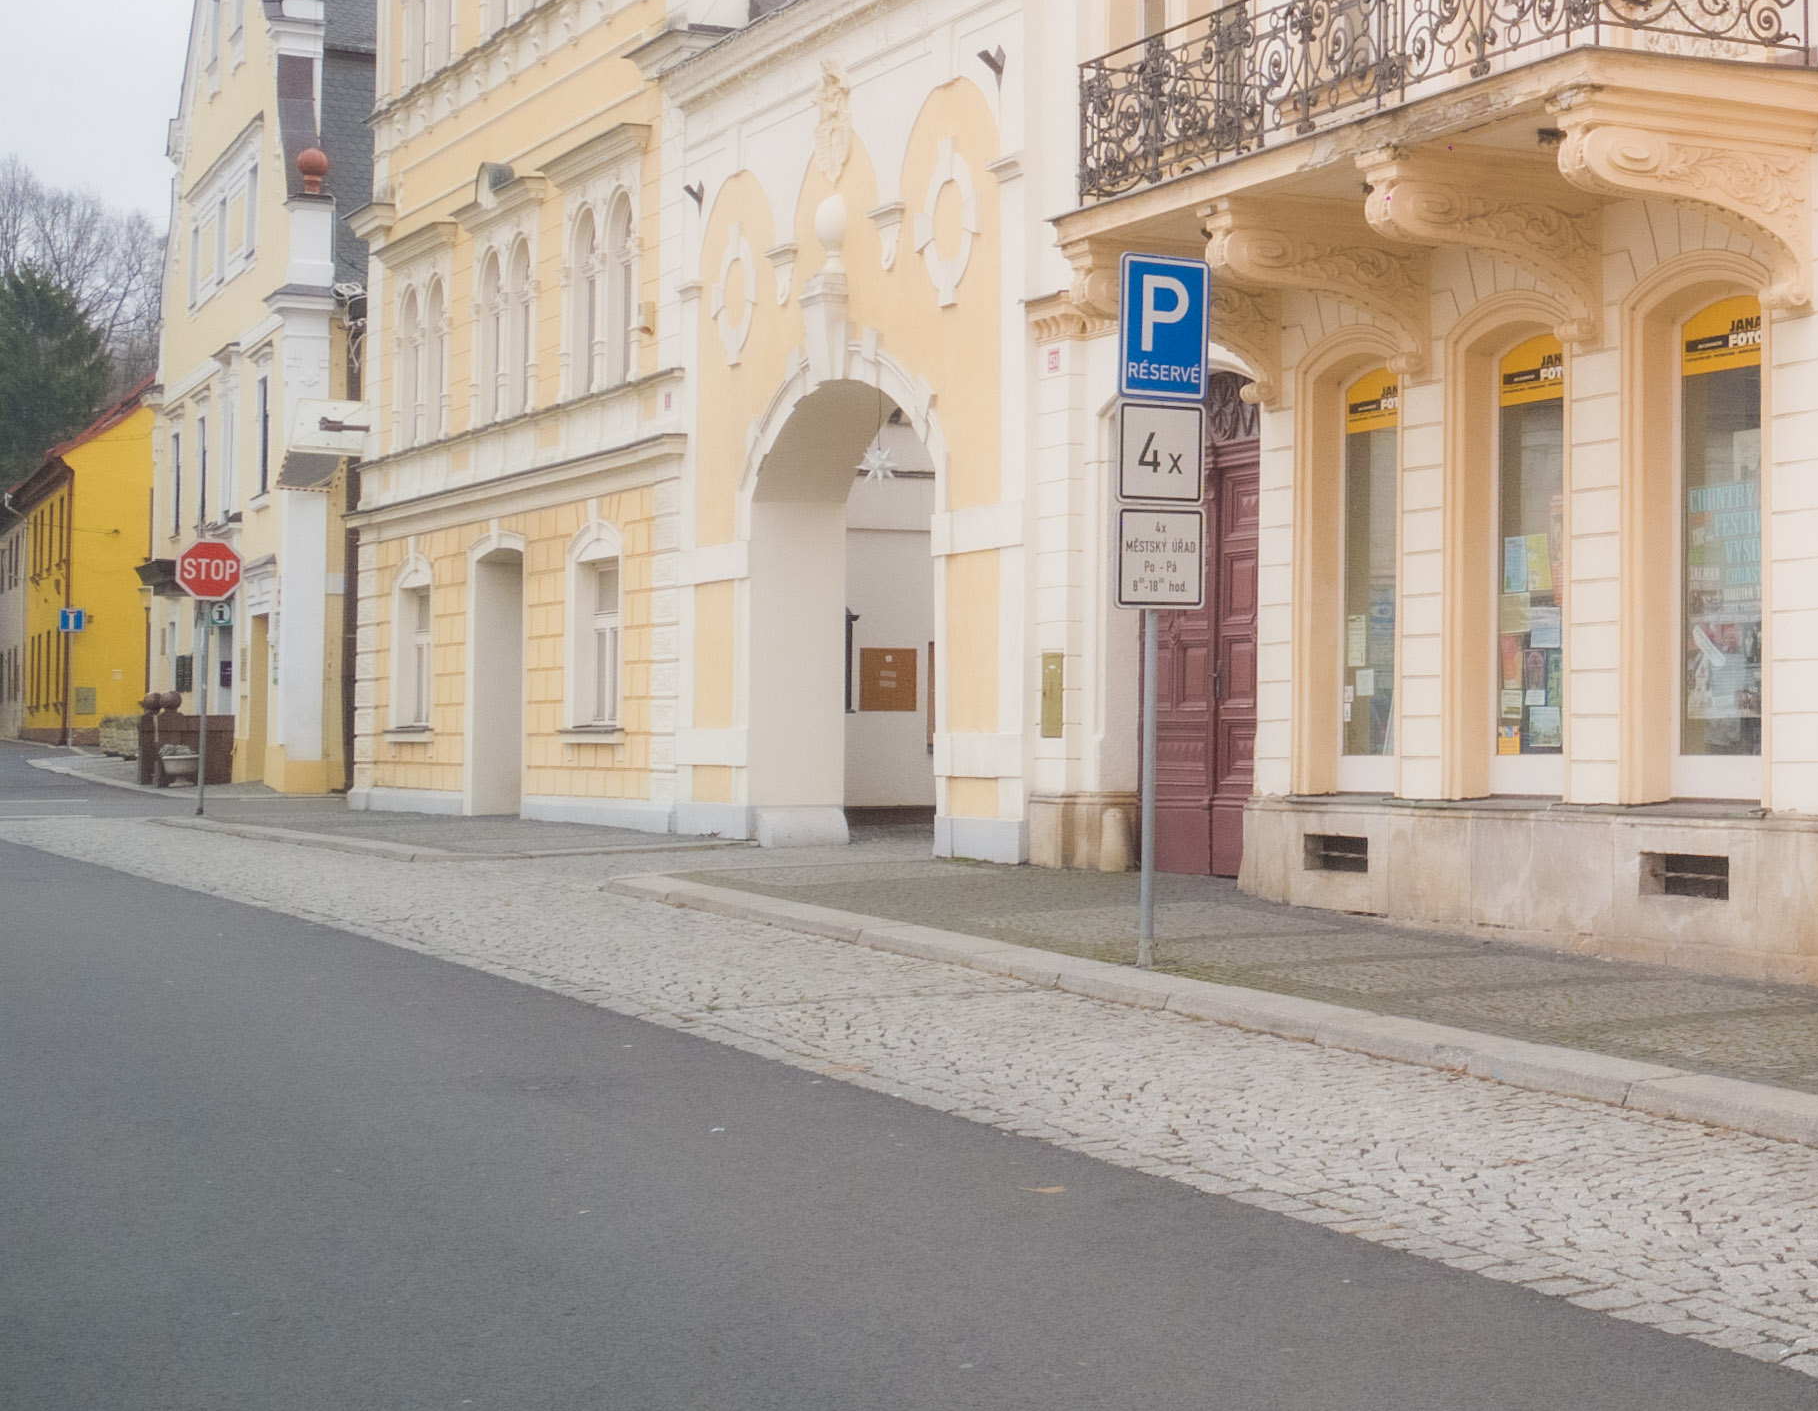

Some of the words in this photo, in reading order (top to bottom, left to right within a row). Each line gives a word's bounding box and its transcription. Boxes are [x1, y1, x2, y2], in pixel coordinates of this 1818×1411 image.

[1141, 274, 1190, 352] P
[1127, 359, 1200, 383] RÉSERVÉ
[1689, 482, 1756, 513] COUNTRY
[1125, 537, 1167, 553] MĚSTSKÝ
[1172, 538, 1196, 553] ÚŘAD
[183, 557, 238, 581] STOP
[1144, 560, 1155, 573] Po
[1166, 560, 1177, 573] Pá
